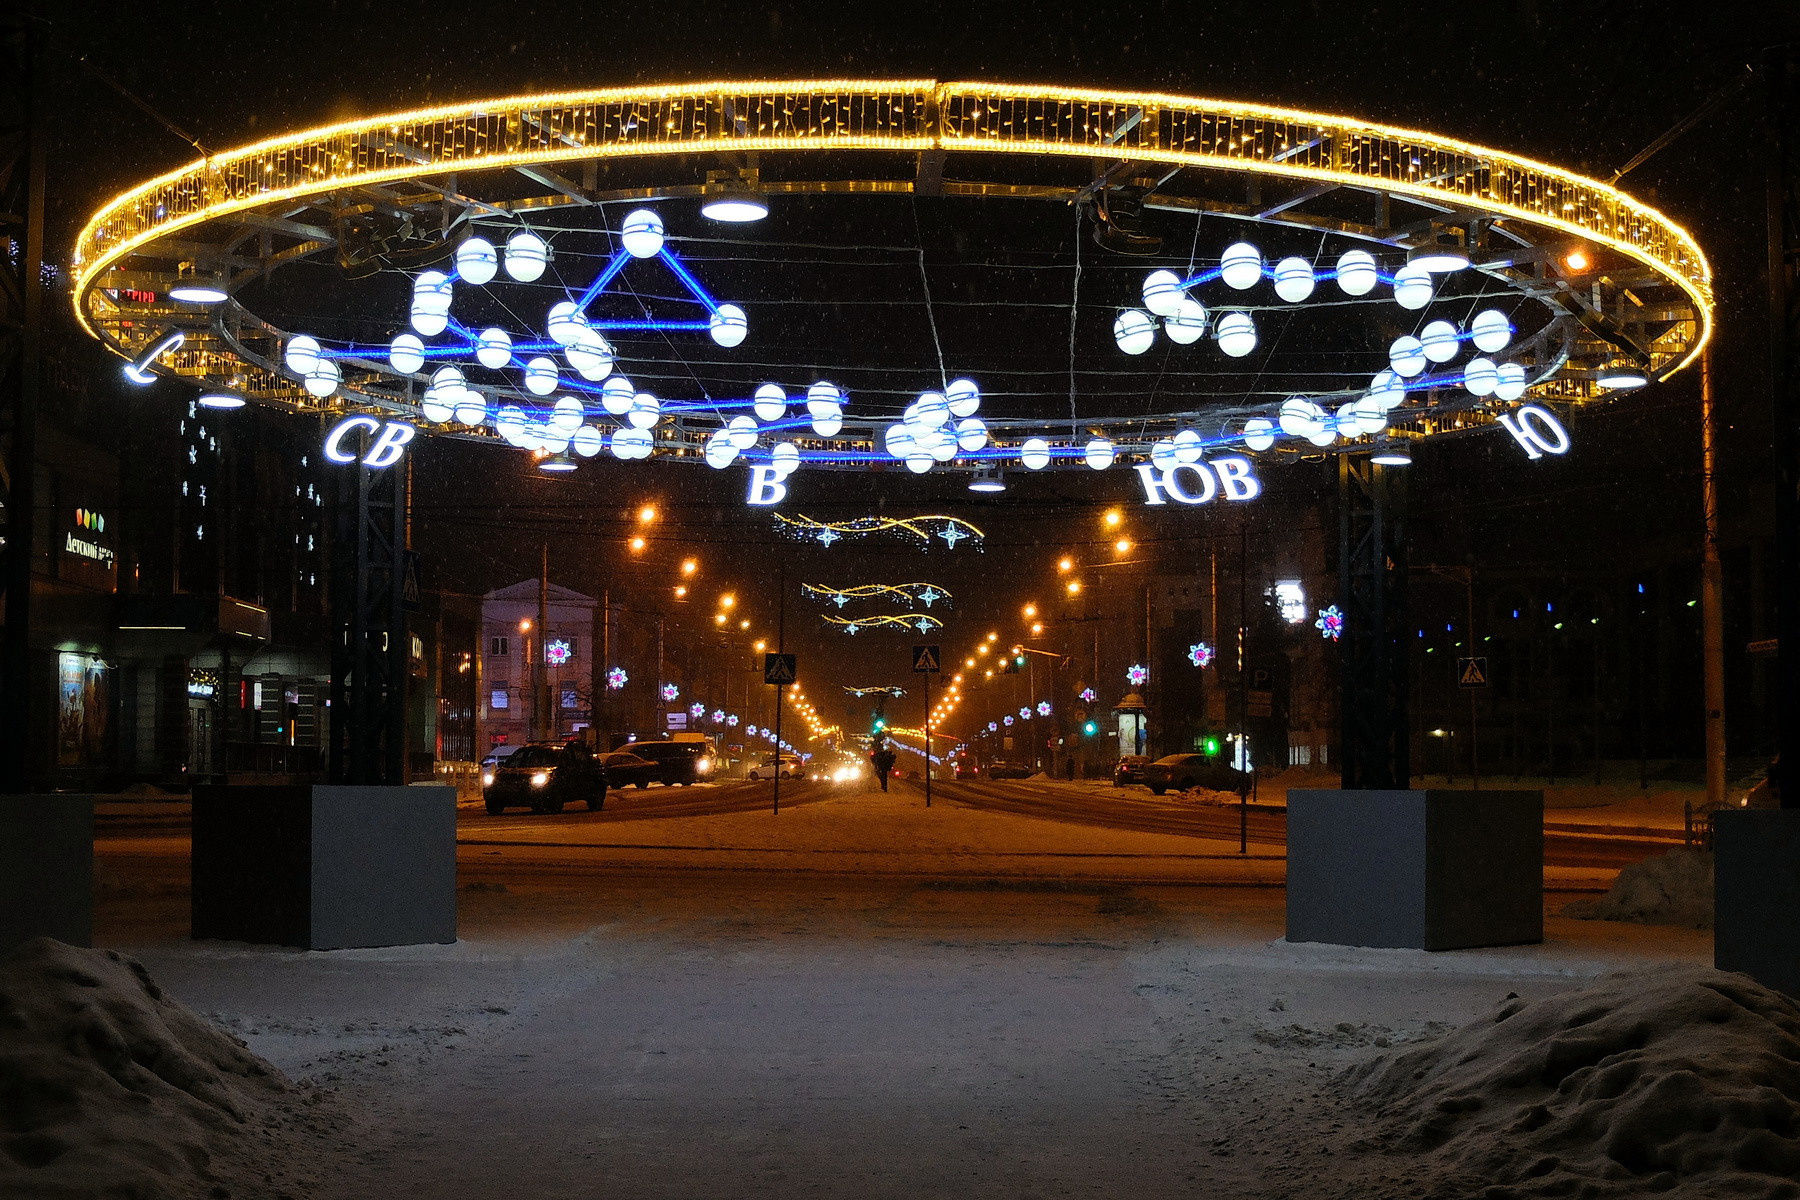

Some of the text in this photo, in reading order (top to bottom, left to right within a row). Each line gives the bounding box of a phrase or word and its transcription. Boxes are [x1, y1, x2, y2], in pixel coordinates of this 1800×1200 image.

[325, 417, 415, 467] СВ
[1495, 406, 1569, 460] Ю
[746, 465, 788, 505] В
[1133, 458, 1259, 505] ЮВ
[65, 531, 97, 560] Детский
